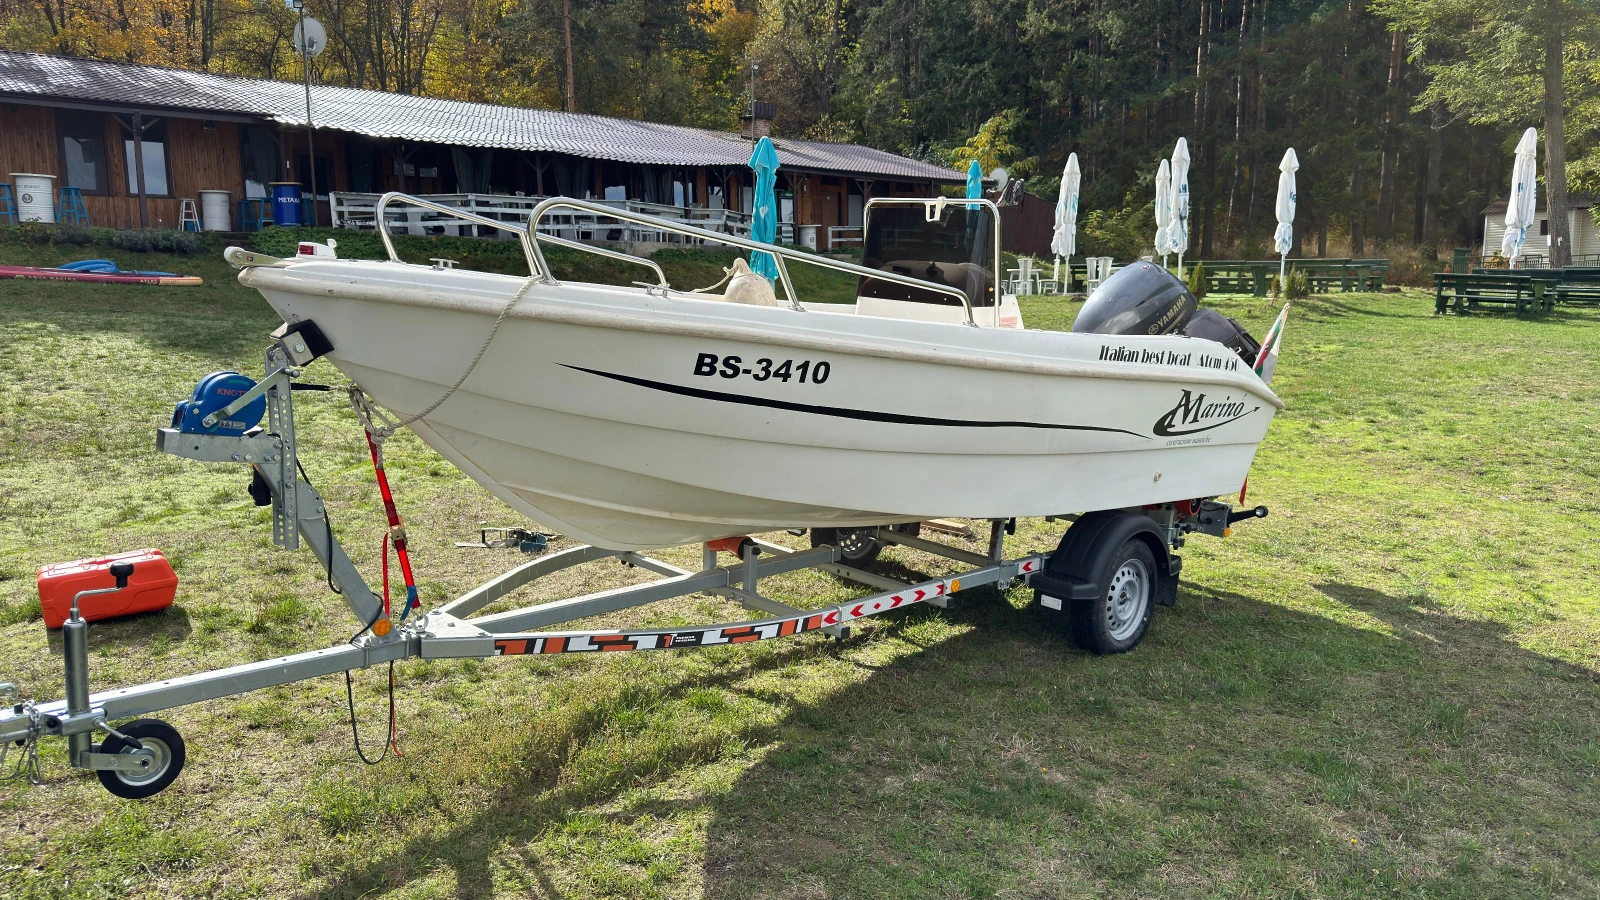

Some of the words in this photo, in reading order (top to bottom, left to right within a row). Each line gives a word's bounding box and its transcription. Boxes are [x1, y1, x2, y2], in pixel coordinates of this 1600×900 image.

[1157, 294, 1186, 327] YAMAHA
[693, 352, 831, 384] BS-3410
[1098, 345, 1140, 363] Italian
[1140, 348, 1166, 365] best
[1166, 350, 1192, 367] boat
[1197, 353, 1222, 369] Atom
[1223, 357, 1240, 372] 450
[217, 388, 248, 397] KNOT
[1153, 389, 1246, 436] Marino
